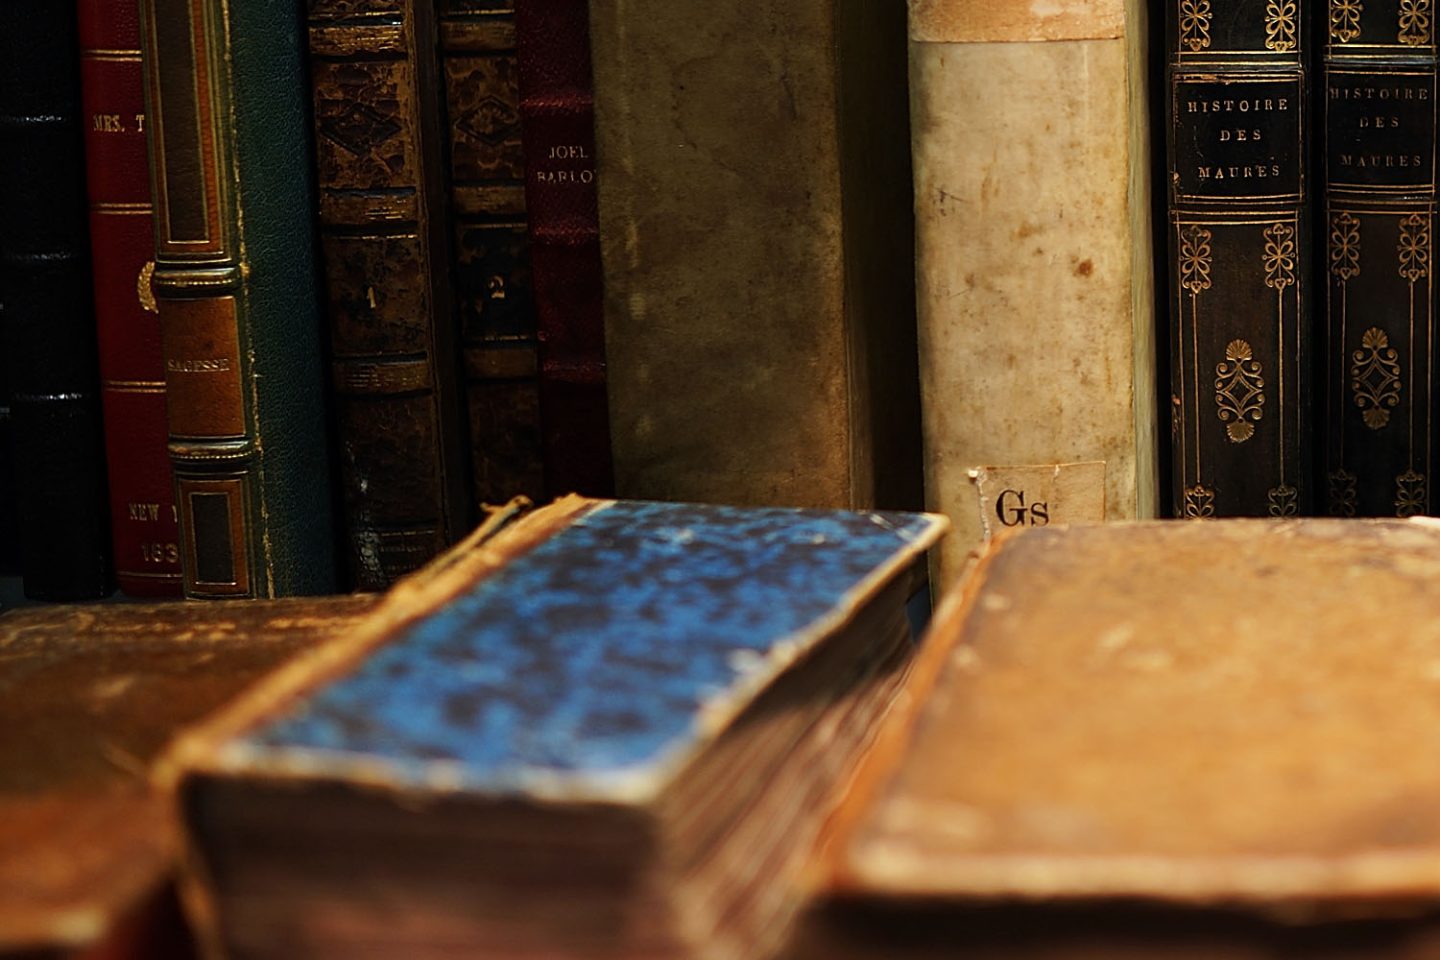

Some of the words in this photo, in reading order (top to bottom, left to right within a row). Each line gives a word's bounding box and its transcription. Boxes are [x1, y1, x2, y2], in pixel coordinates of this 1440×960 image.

[1329, 86, 1429, 100] HISTOIRE
[1188, 98, 1288, 113] HISTOIRE
[1359, 116, 1399, 128] DES
[1220, 129, 1262, 141] DES
[549, 146, 589, 159] JOEL
[1341, 154, 1422, 168] MAURES
[1198, 165, 1281, 179] MAURES
[489, 275, 505, 299] 2
[996, 489, 1050, 527] Gs
